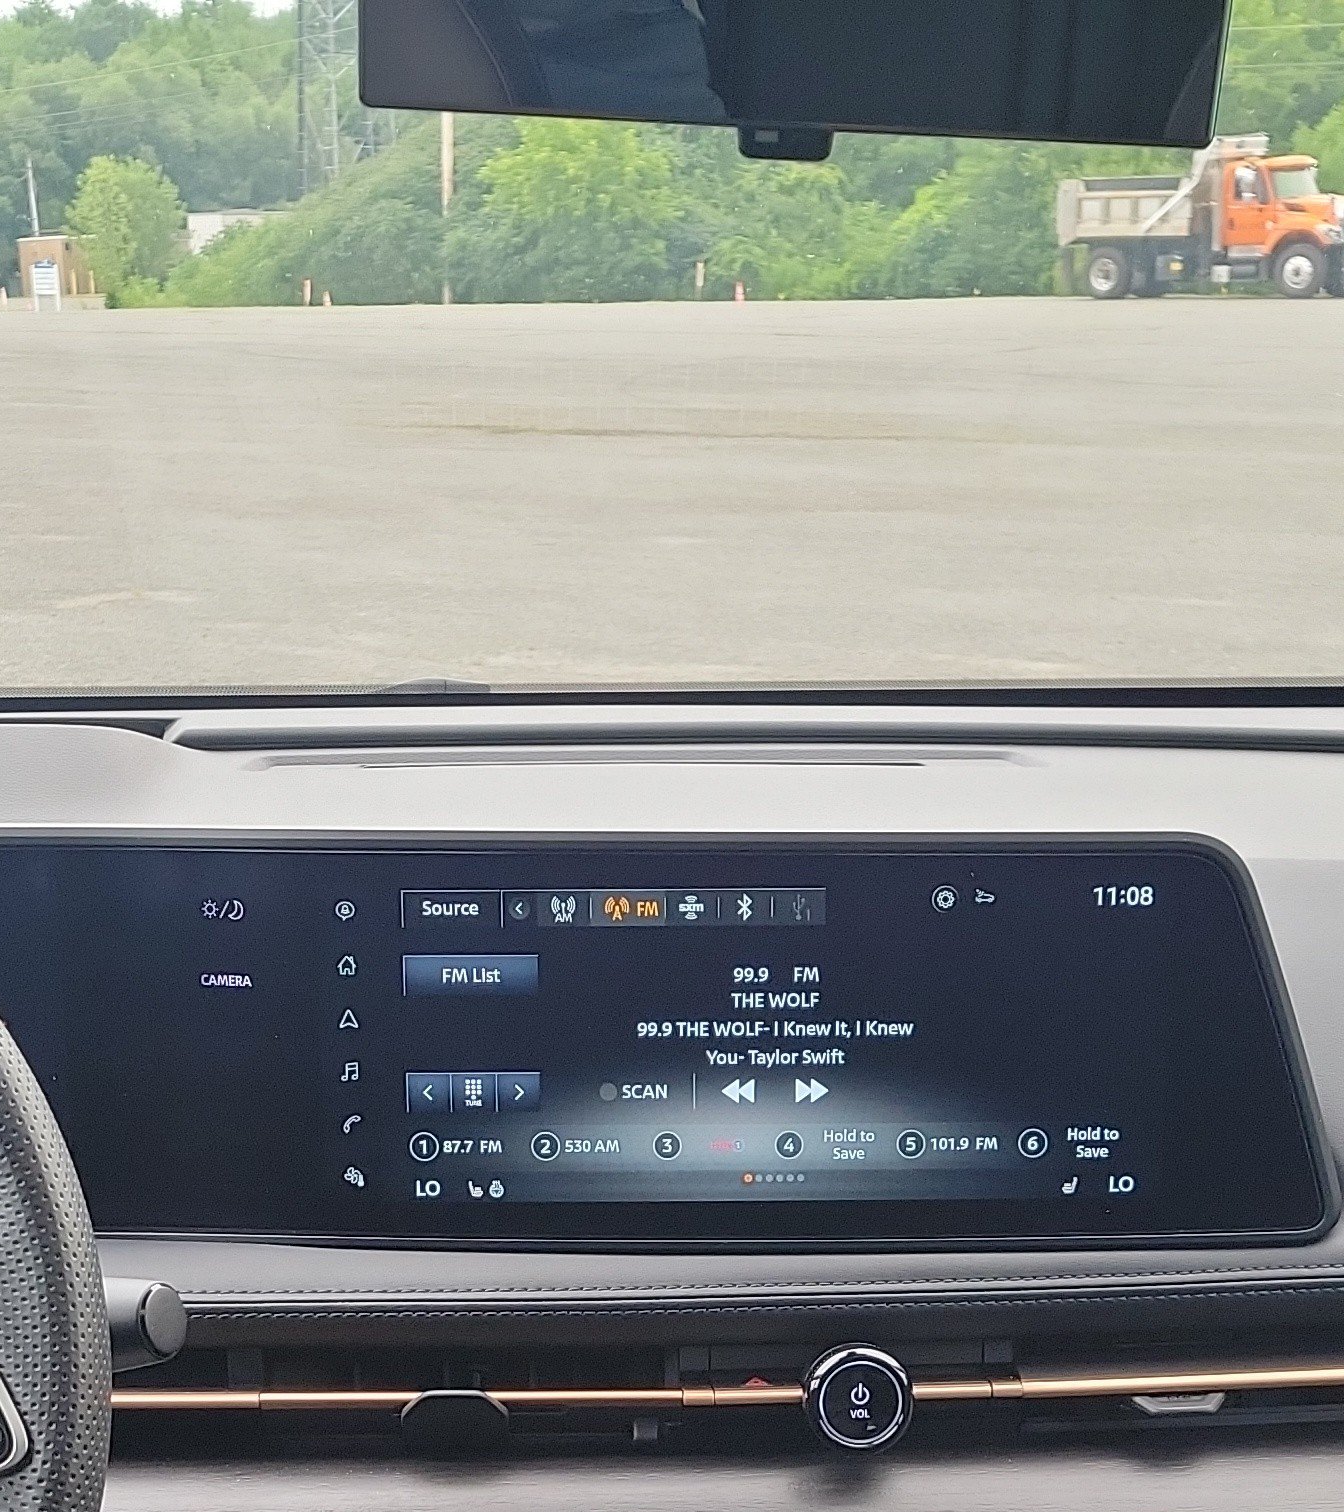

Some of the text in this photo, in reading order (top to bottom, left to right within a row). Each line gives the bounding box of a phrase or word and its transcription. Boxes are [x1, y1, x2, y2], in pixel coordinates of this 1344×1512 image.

[1093, 886, 1154, 906] 11:08
[422, 901, 479, 916] Source
[637, 901, 659, 917] FM
[200, 973, 252, 988] CAMERA
[441, 967, 501, 983] FM List
[733, 967, 820, 983] 99.9 FM
[731, 992, 820, 1008] THE WOLF
[637, 1020, 914, 1038] 99.9 THE WOLF- I Knew It, I Knew
[706, 1049, 845, 1068] You- Taylor Swift
[621, 1084, 668, 1099] SCAN
[823, 1128, 875, 1144] Hold to
[1067, 1126, 1120, 1142] Hold to
[442, 1139, 474, 1154] 87.7
[480, 1139, 503, 1154] FM
[564, 1138, 592, 1154] 530
[594, 1138, 620, 1154] AM
[930, 1136, 969, 1152] 101.9
[975, 1136, 998, 1151] FM
[1075, 1144, 1109, 1159] Save
[832, 1146, 866, 1162] Save
[416, 1181, 441, 1197] LO
[1109, 1176, 1134, 1193] LO
[850, 1409, 870, 1419] VOL
